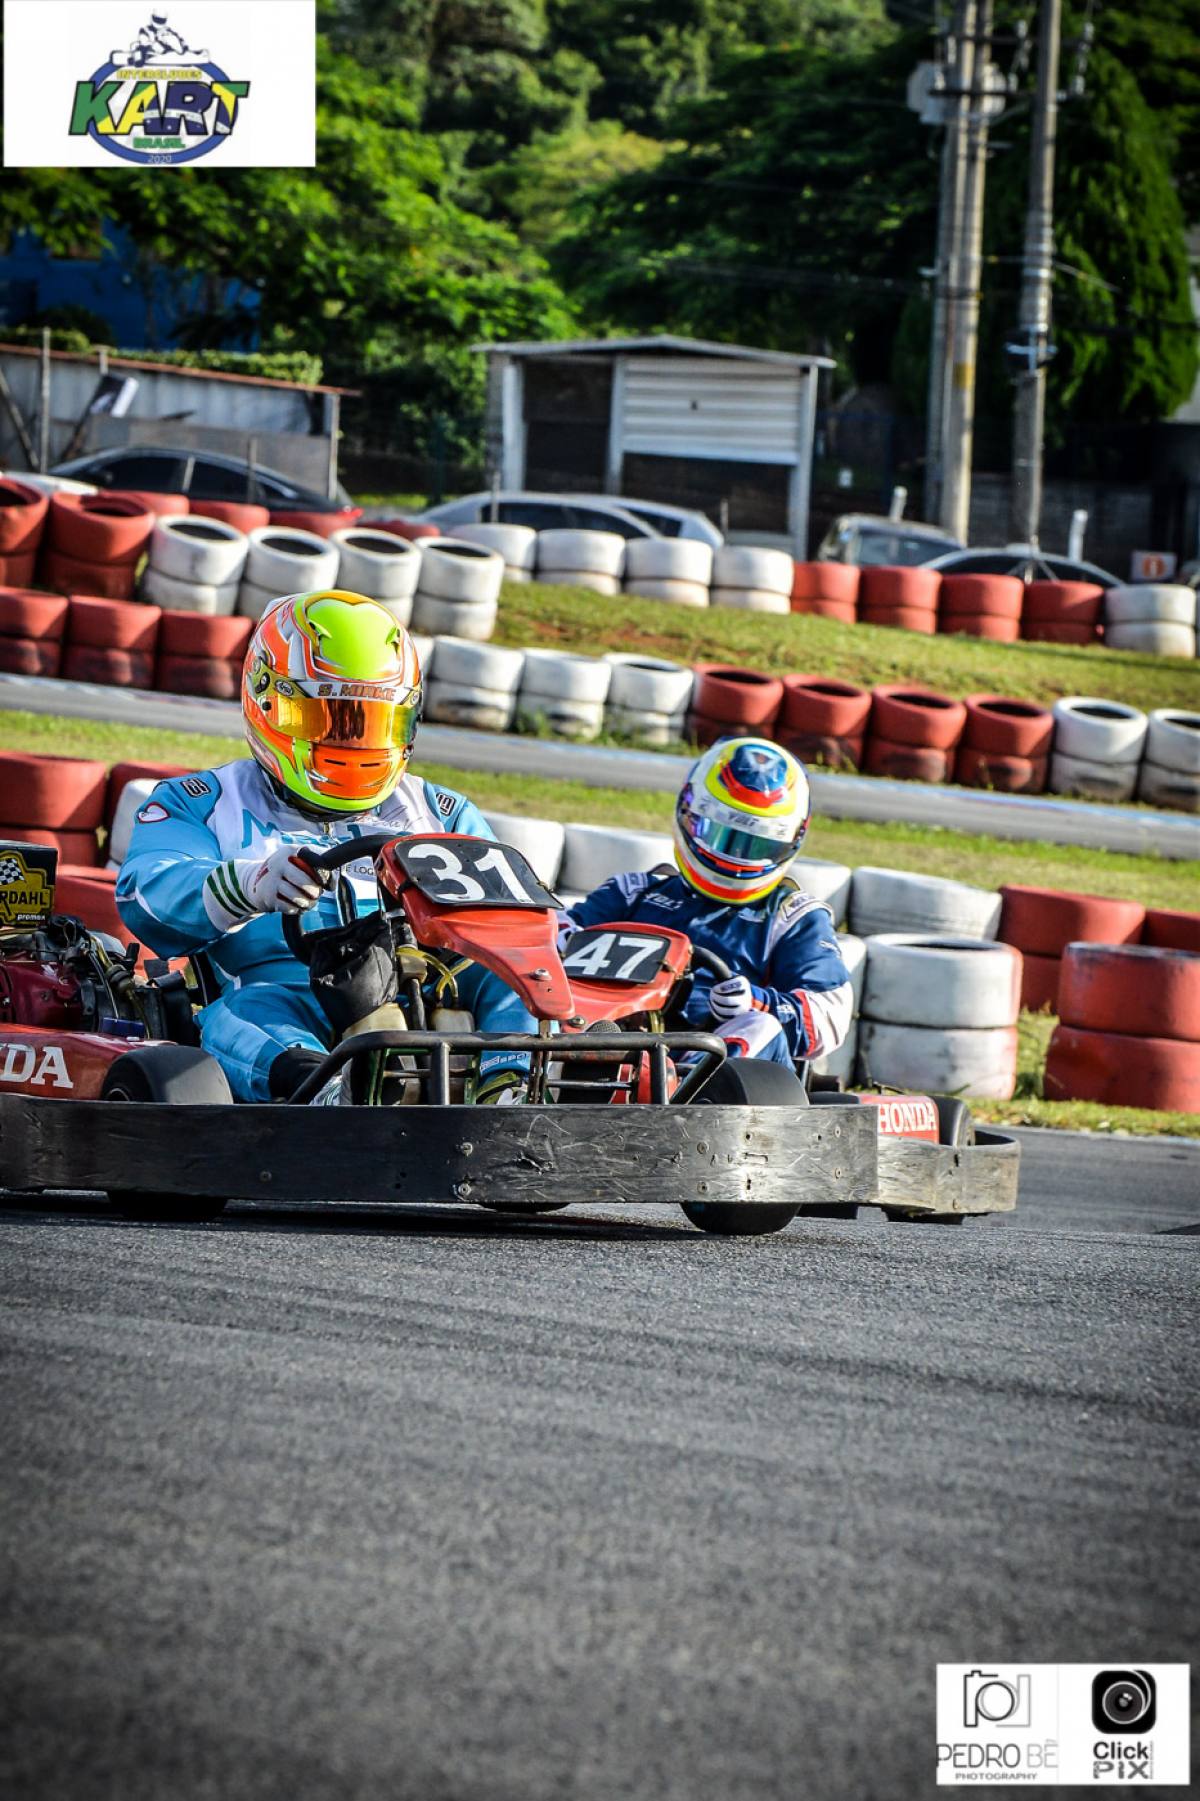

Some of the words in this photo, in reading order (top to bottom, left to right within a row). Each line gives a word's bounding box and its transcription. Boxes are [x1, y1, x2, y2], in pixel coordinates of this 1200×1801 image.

[408, 843, 536, 903] 31
[563, 933, 665, 979] 47
[878, 1103, 936, 1133] HONDA
